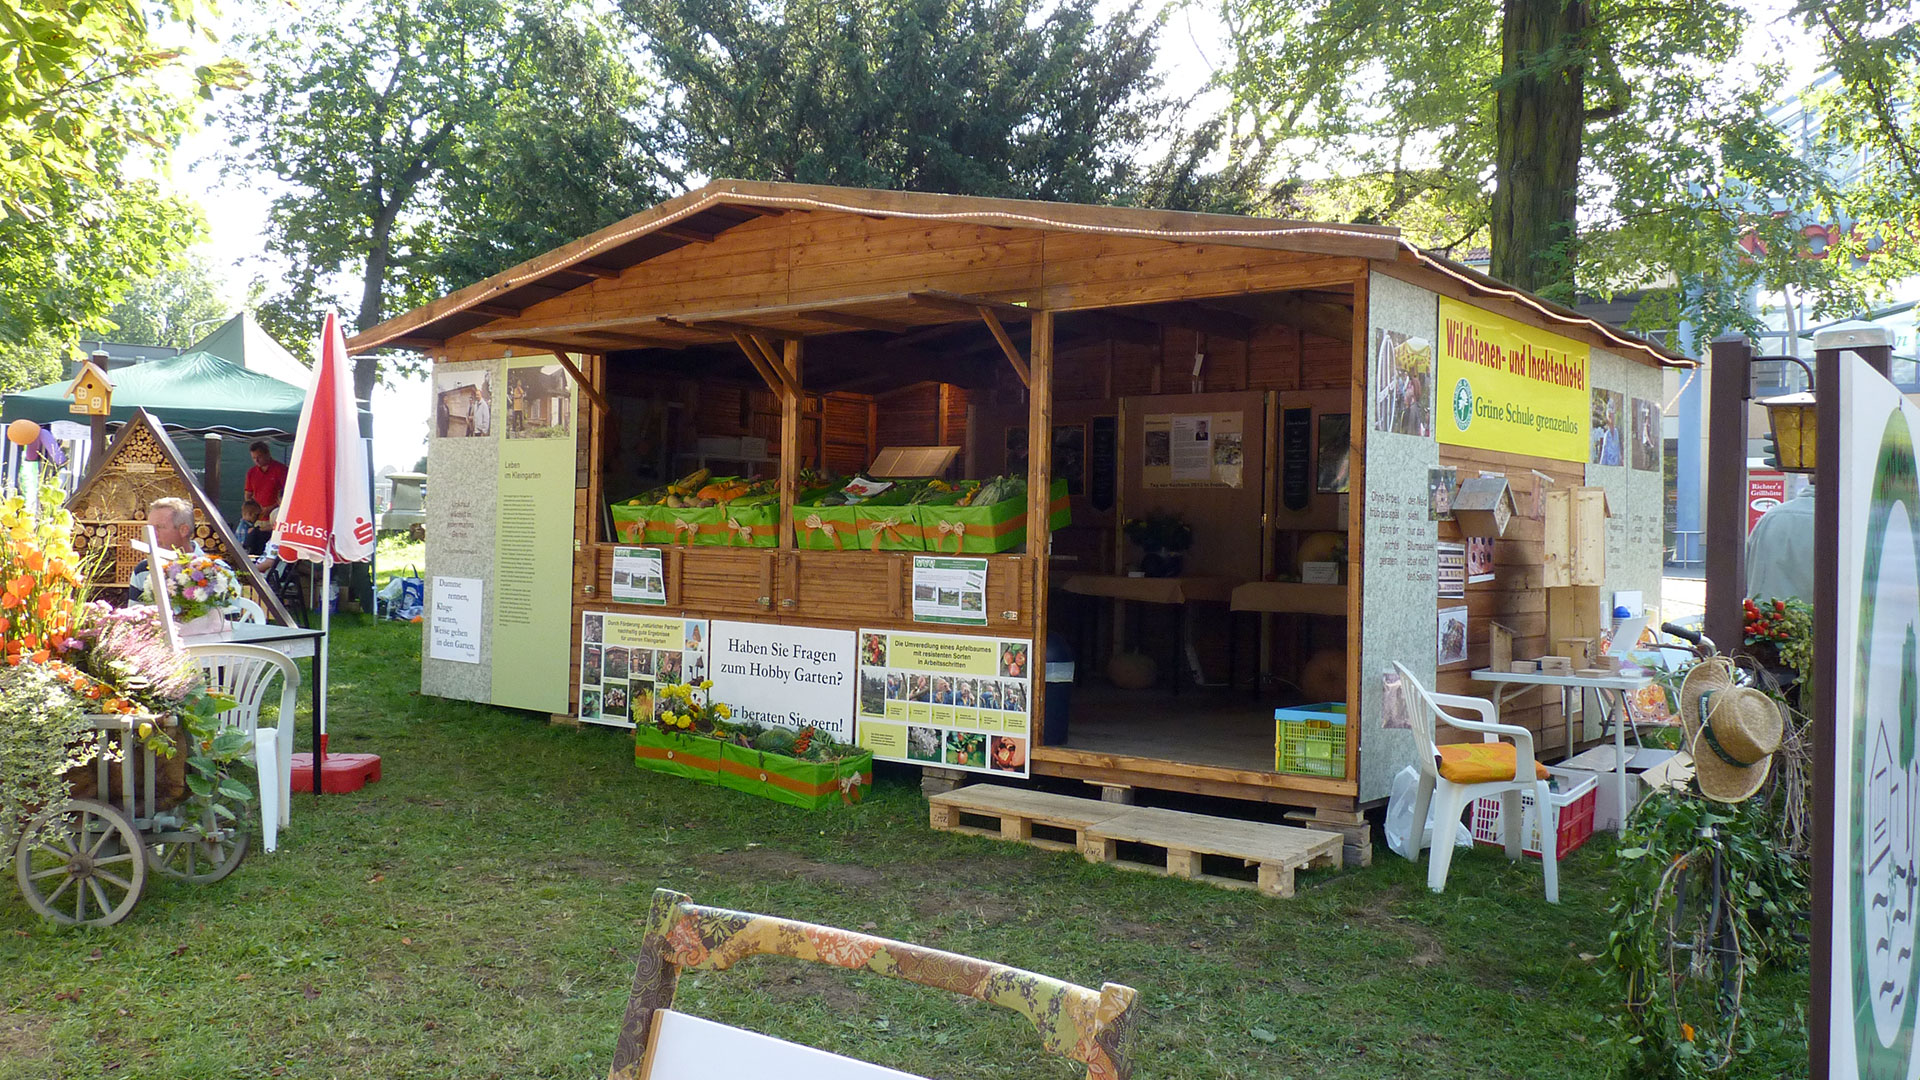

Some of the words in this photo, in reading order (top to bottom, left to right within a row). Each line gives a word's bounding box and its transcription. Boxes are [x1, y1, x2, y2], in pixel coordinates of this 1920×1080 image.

[1446, 318, 1506, 370] Wildbienen-
[1509, 344, 1526, 377] und
[1528, 343, 1585, 391] Insektenhotel
[1475, 396, 1504, 421] Grüne
[1505, 402, 1534, 427] Schule
[1535, 413, 1578, 435] grenzenlos
[504, 461, 521, 469] Leben
[512, 471, 541, 480] Kleingarten
[439, 579, 461, 588] Dumme
[448, 593, 469, 602] rennen,
[436, 602, 453, 613] Kluge
[437, 617, 458, 625] warten,
[620, 621, 640, 629] Förderung
[434, 625, 450, 635] Weise
[450, 627, 468, 638] gehen
[617, 628, 638, 636] nachhaltig
[443, 638, 454, 648] den
[643, 637, 667, 645] Kleingarten
[894, 640, 904, 648] Die
[904, 641, 940, 651] Umveredlung
[956, 645, 992, 653] Apfelbaumes
[728, 639, 768, 656] Haben
[771, 642, 790, 658] Sie
[793, 644, 836, 665] Fragen
[922, 651, 953, 659] resistenten
[953, 652, 972, 661] Sorten
[924, 660, 966, 669] Arbeitsschritten
[720, 663, 746, 675] zum
[750, 662, 791, 684] Hobby
[794, 667, 843, 686] Garten?
[741, 706, 785, 724] beraten
[789, 711, 807, 727] Sie
